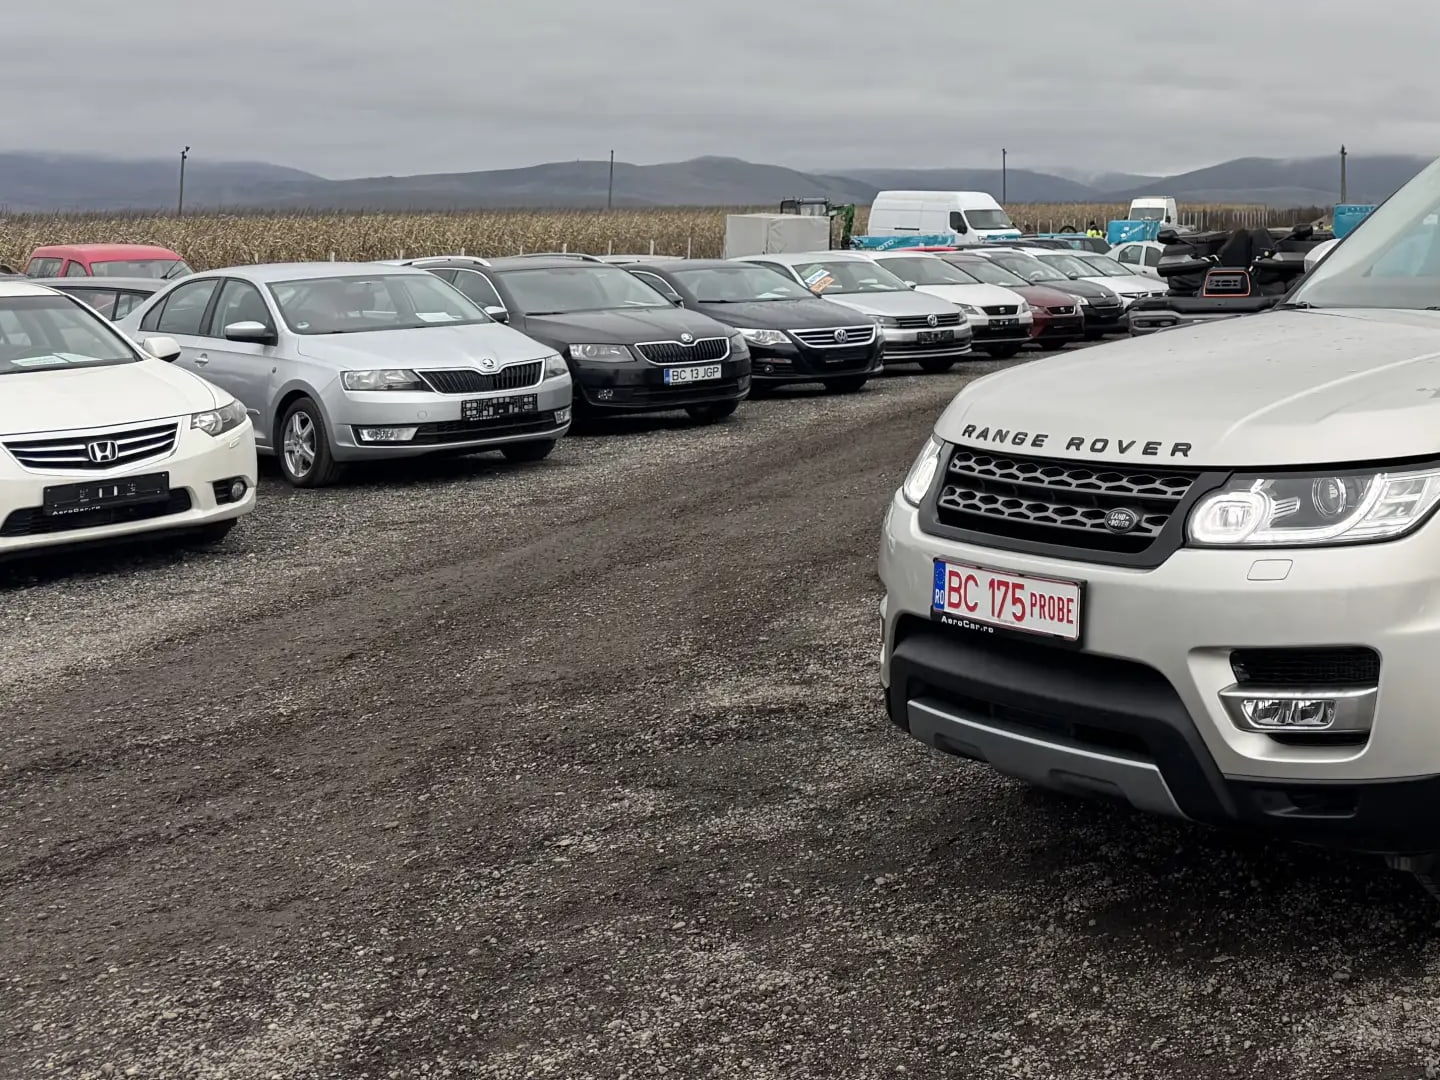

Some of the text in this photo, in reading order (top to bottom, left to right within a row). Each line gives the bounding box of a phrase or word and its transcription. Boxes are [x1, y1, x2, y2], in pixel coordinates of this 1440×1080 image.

[671, 366, 719, 381] BC 13 JGP
[962, 424, 1192, 457] RANGE ROVER
[935, 589, 945, 605] RO
[947, 570, 1074, 625] BC 175 PROBE
[941, 616, 994, 634] AeroCar.ro
